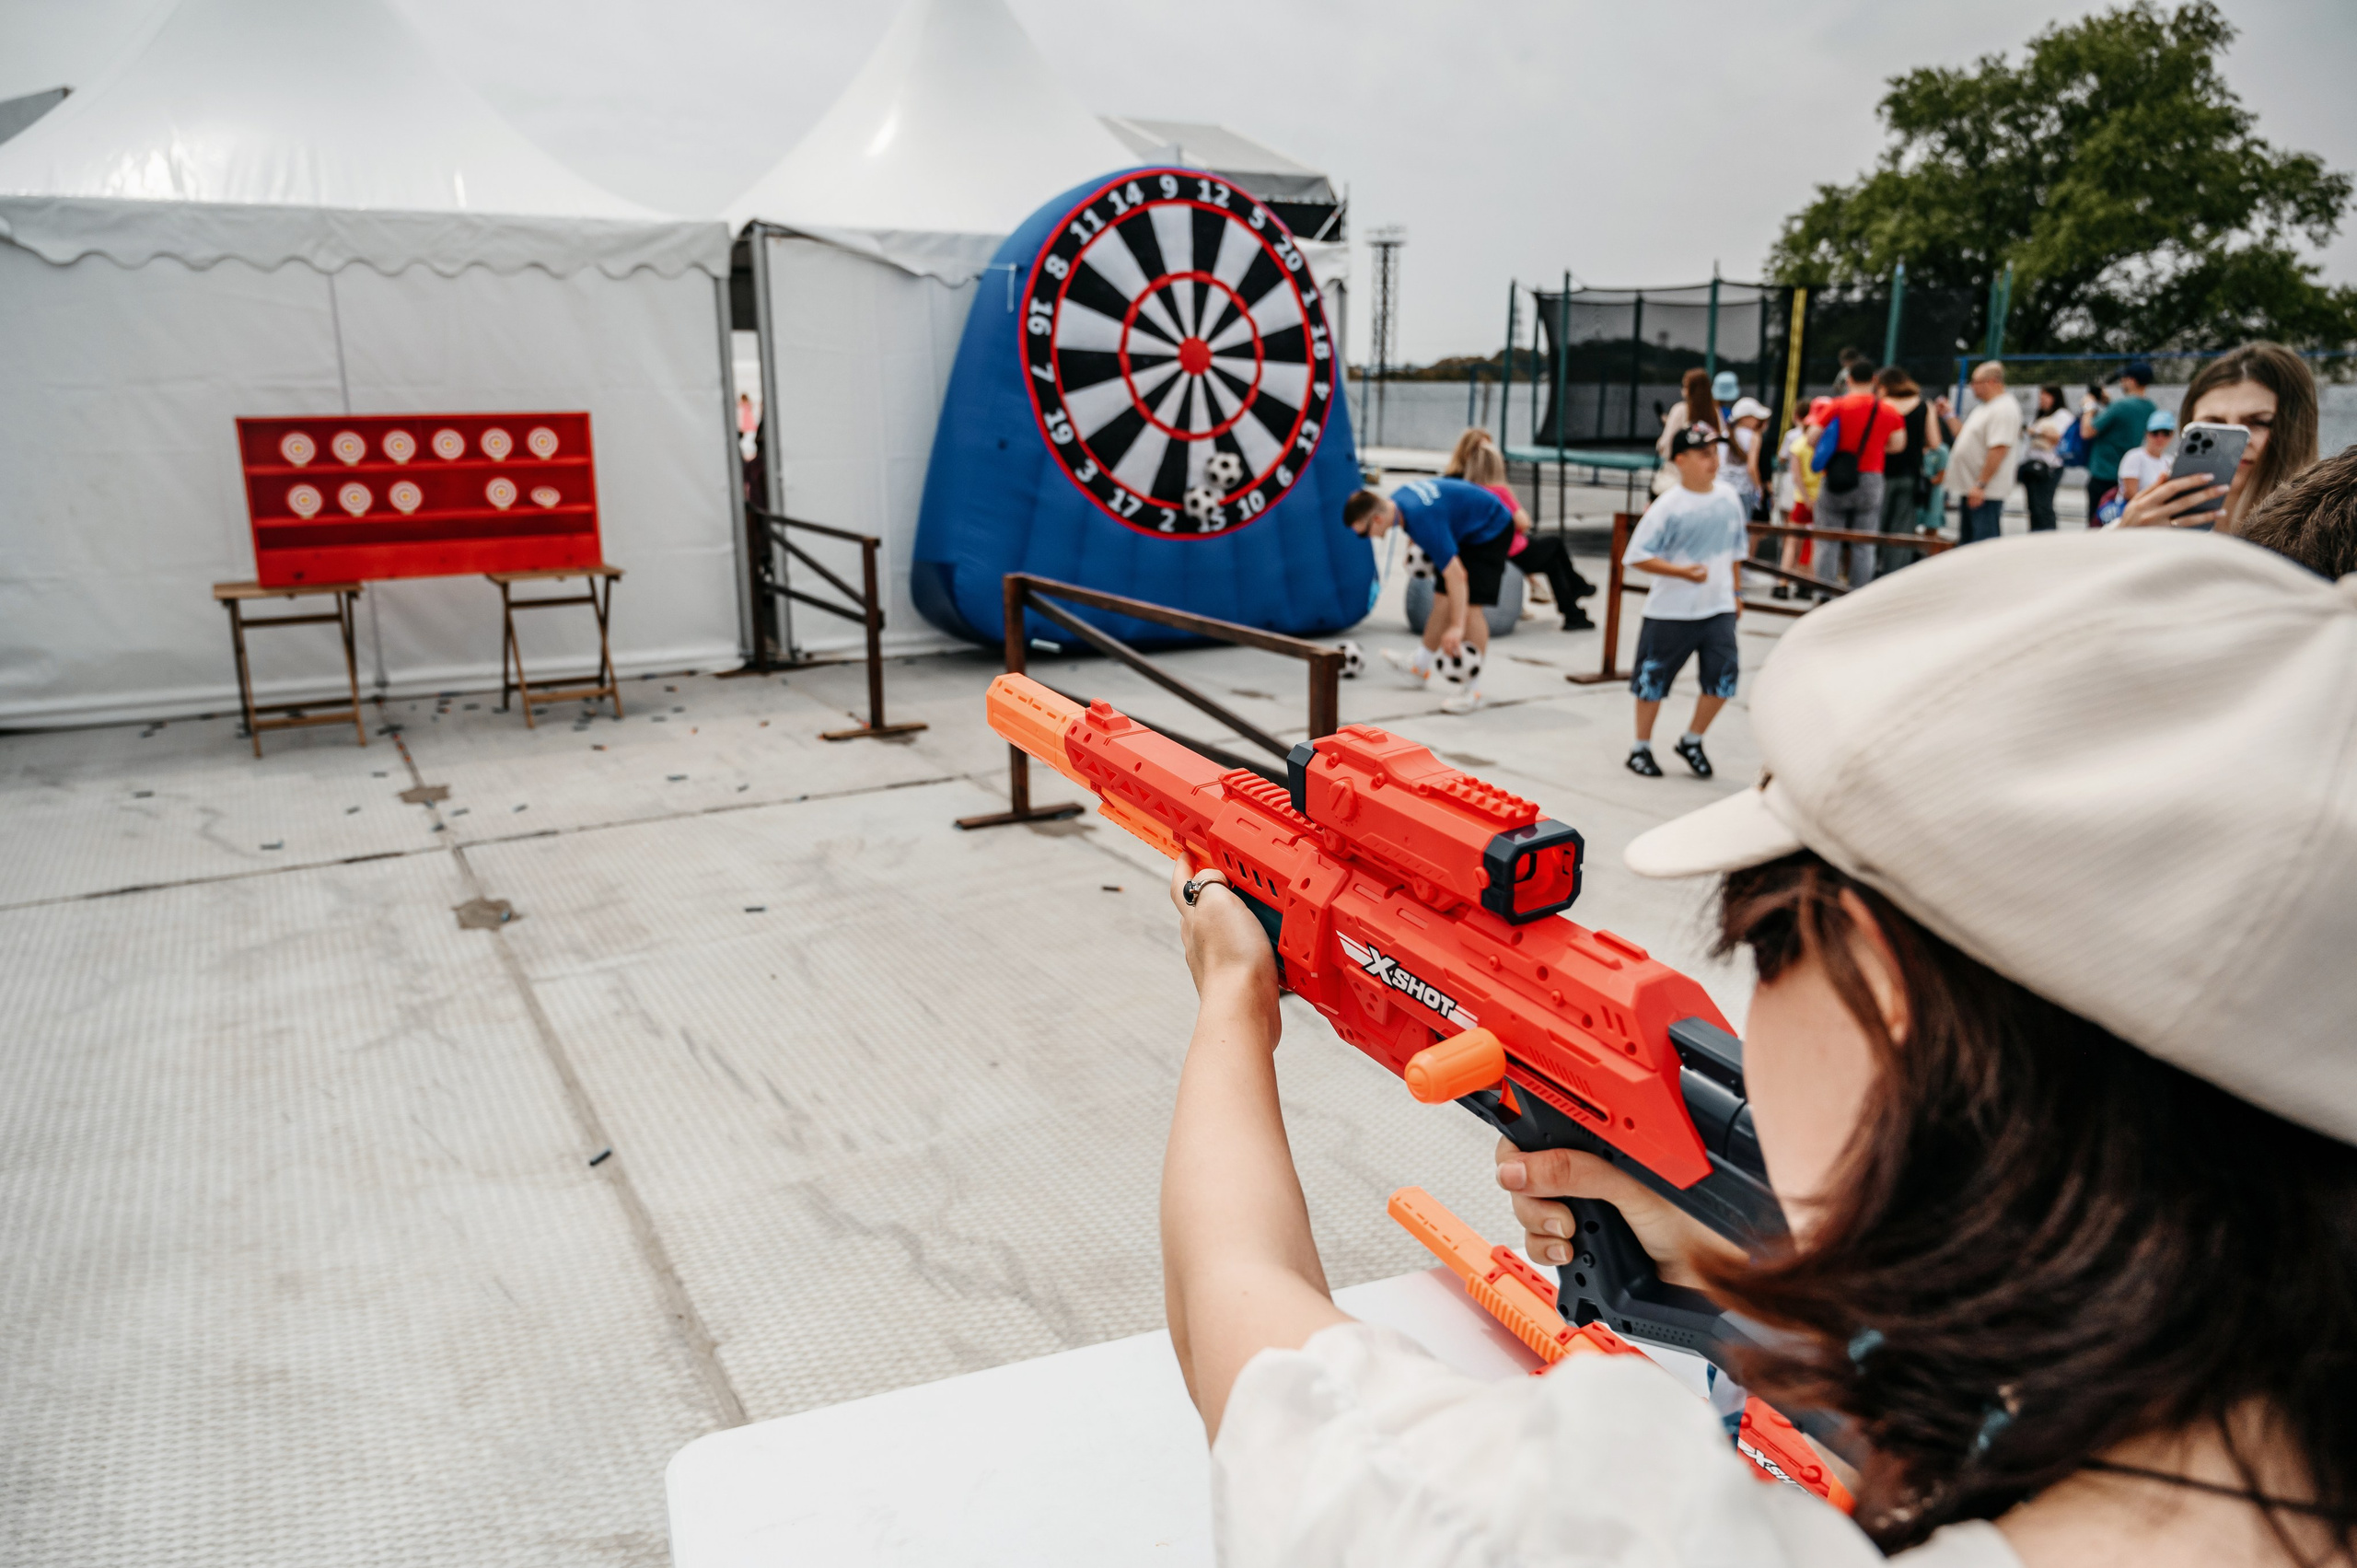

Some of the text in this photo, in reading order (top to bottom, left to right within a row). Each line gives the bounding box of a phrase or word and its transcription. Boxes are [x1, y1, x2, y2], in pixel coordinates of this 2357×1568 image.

[1108, 180, 1144, 215] 14
[1158, 174, 1178, 200] 9
[1197, 179, 1231, 209] 12
[1069, 208, 1107, 246] 11
[1248, 204, 1268, 230] 5
[1273, 233, 1304, 272] 20
[1044, 254, 1070, 281] 8
[1300, 285, 1318, 308] 1
[1028, 296, 1054, 336] 16
[1030, 362, 1056, 384] 7
[1043, 407, 1074, 445] 19
[1074, 459, 1099, 483] 3
[1276, 464, 1294, 488] 6
[1108, 487, 1144, 517] 17
[1237, 490, 1266, 520] 10
[1158, 507, 1178, 532] 2
